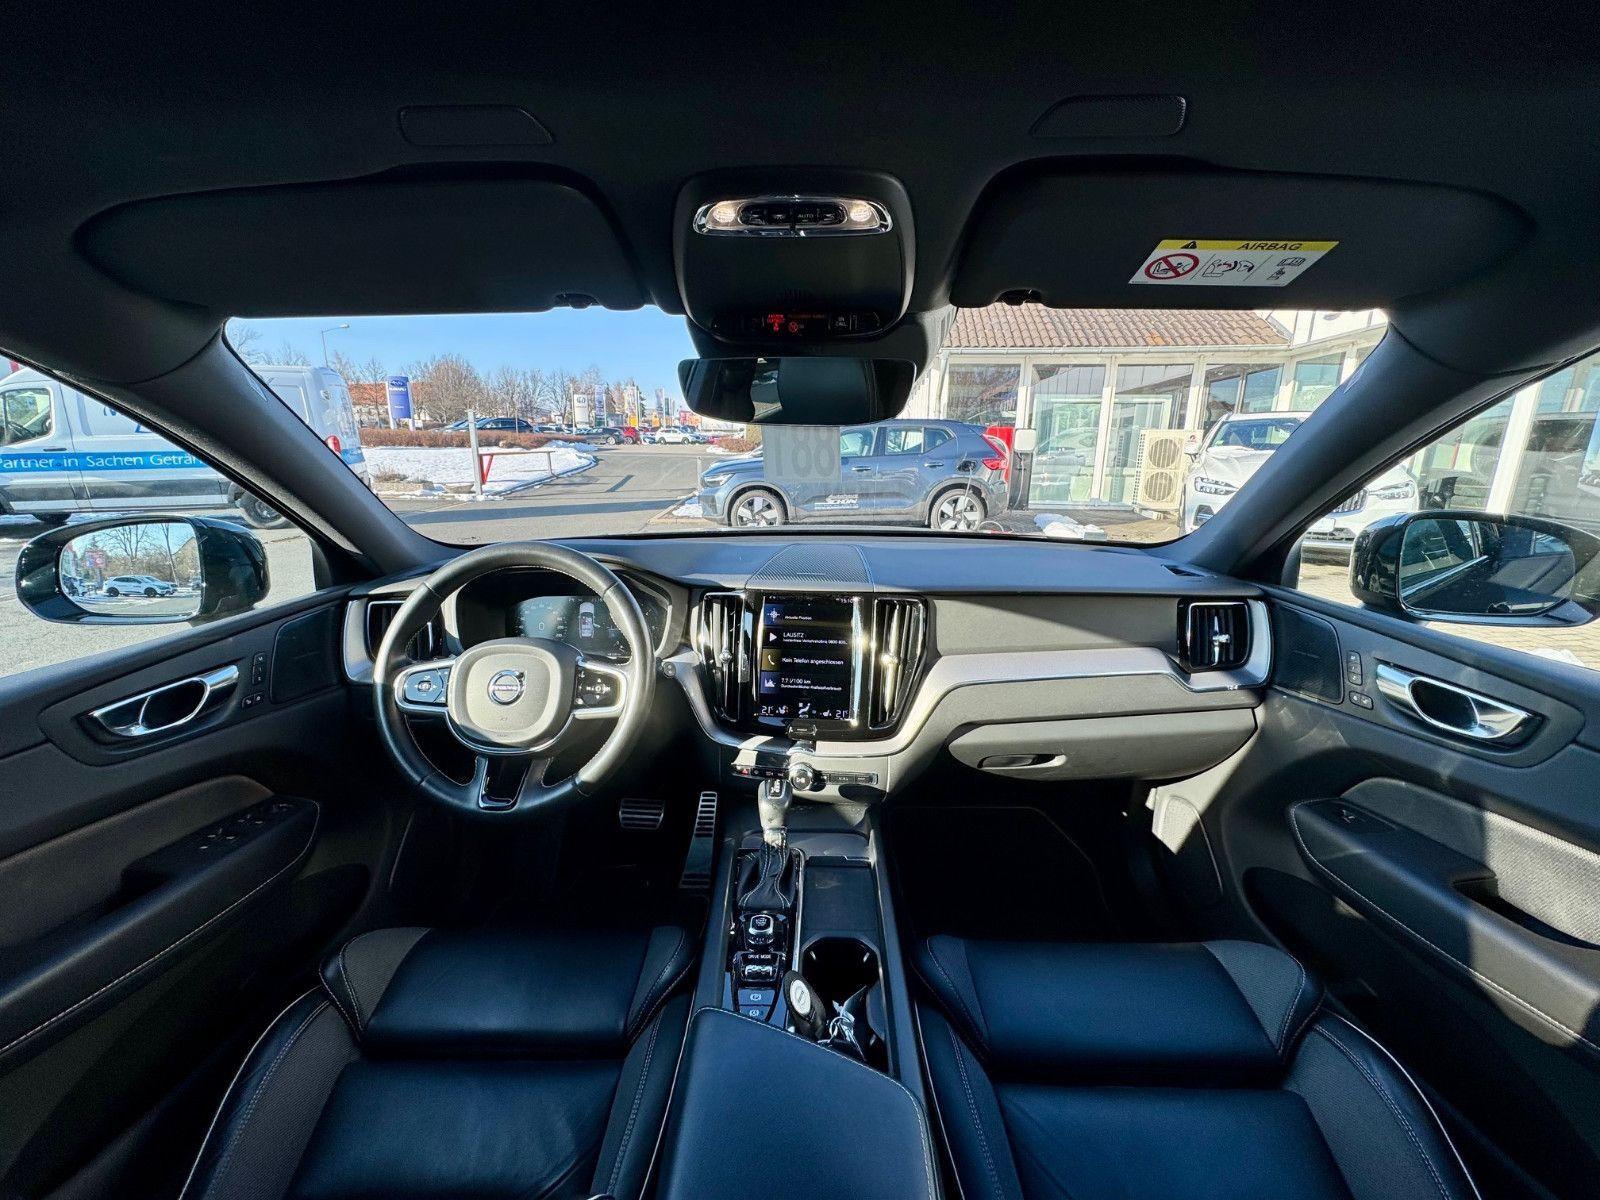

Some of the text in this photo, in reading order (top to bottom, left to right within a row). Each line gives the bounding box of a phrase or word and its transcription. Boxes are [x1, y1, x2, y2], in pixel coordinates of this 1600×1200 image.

[1237, 242, 1303, 251] AIRBAG
[63, 455, 79, 467] in
[86, 455, 144, 467] Sachen
